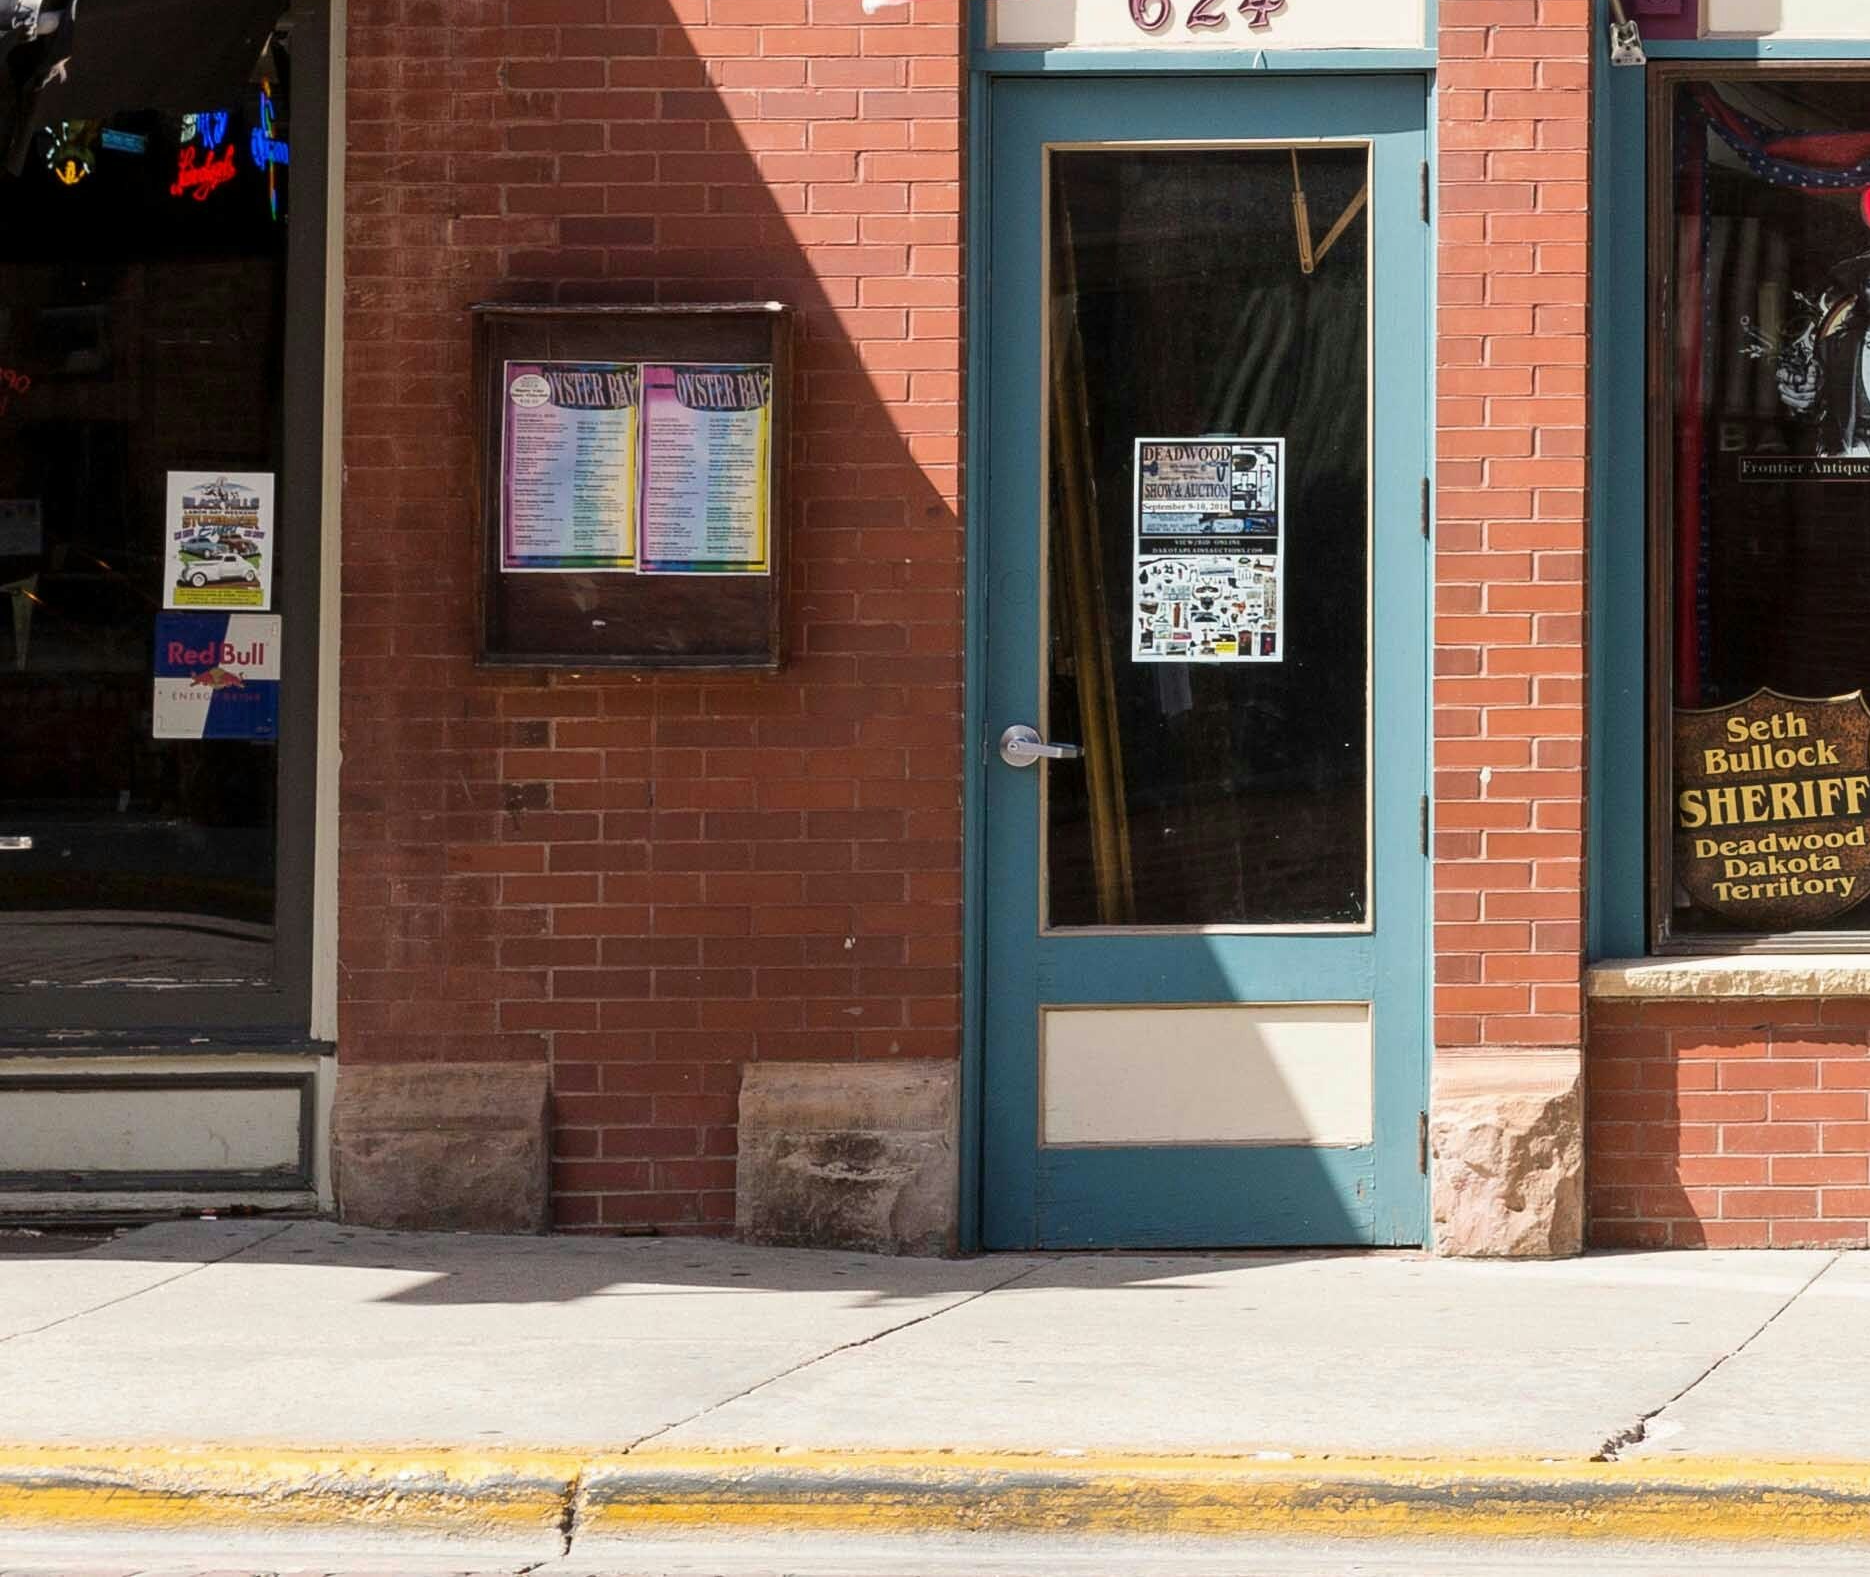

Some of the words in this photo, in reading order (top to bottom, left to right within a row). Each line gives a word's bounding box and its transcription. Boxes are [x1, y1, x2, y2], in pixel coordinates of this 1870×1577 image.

[676, 374, 738, 407] OYSTER
[1144, 446, 1231, 462] DEADWOOD
[1742, 460, 1805, 473] Frontier
[1144, 483, 1173, 498] SHOW
[1174, 483, 1183, 498] &
[1185, 482, 1229, 498] AUCTION
[1143, 502, 1185, 512] September
[168, 641, 216, 665] Red
[220, 642, 264, 665] Bull
[172, 692, 211, 702] ENERG
[1726, 711, 1809, 744] Seth
[1704, 739, 1841, 775] Bullock
[1679, 775, 1870, 829] SHERIFF
[1695, 825, 1866, 859] Deadwood
[1724, 852, 1841, 879] Dakota
[1712, 876, 1857, 902] Territory
